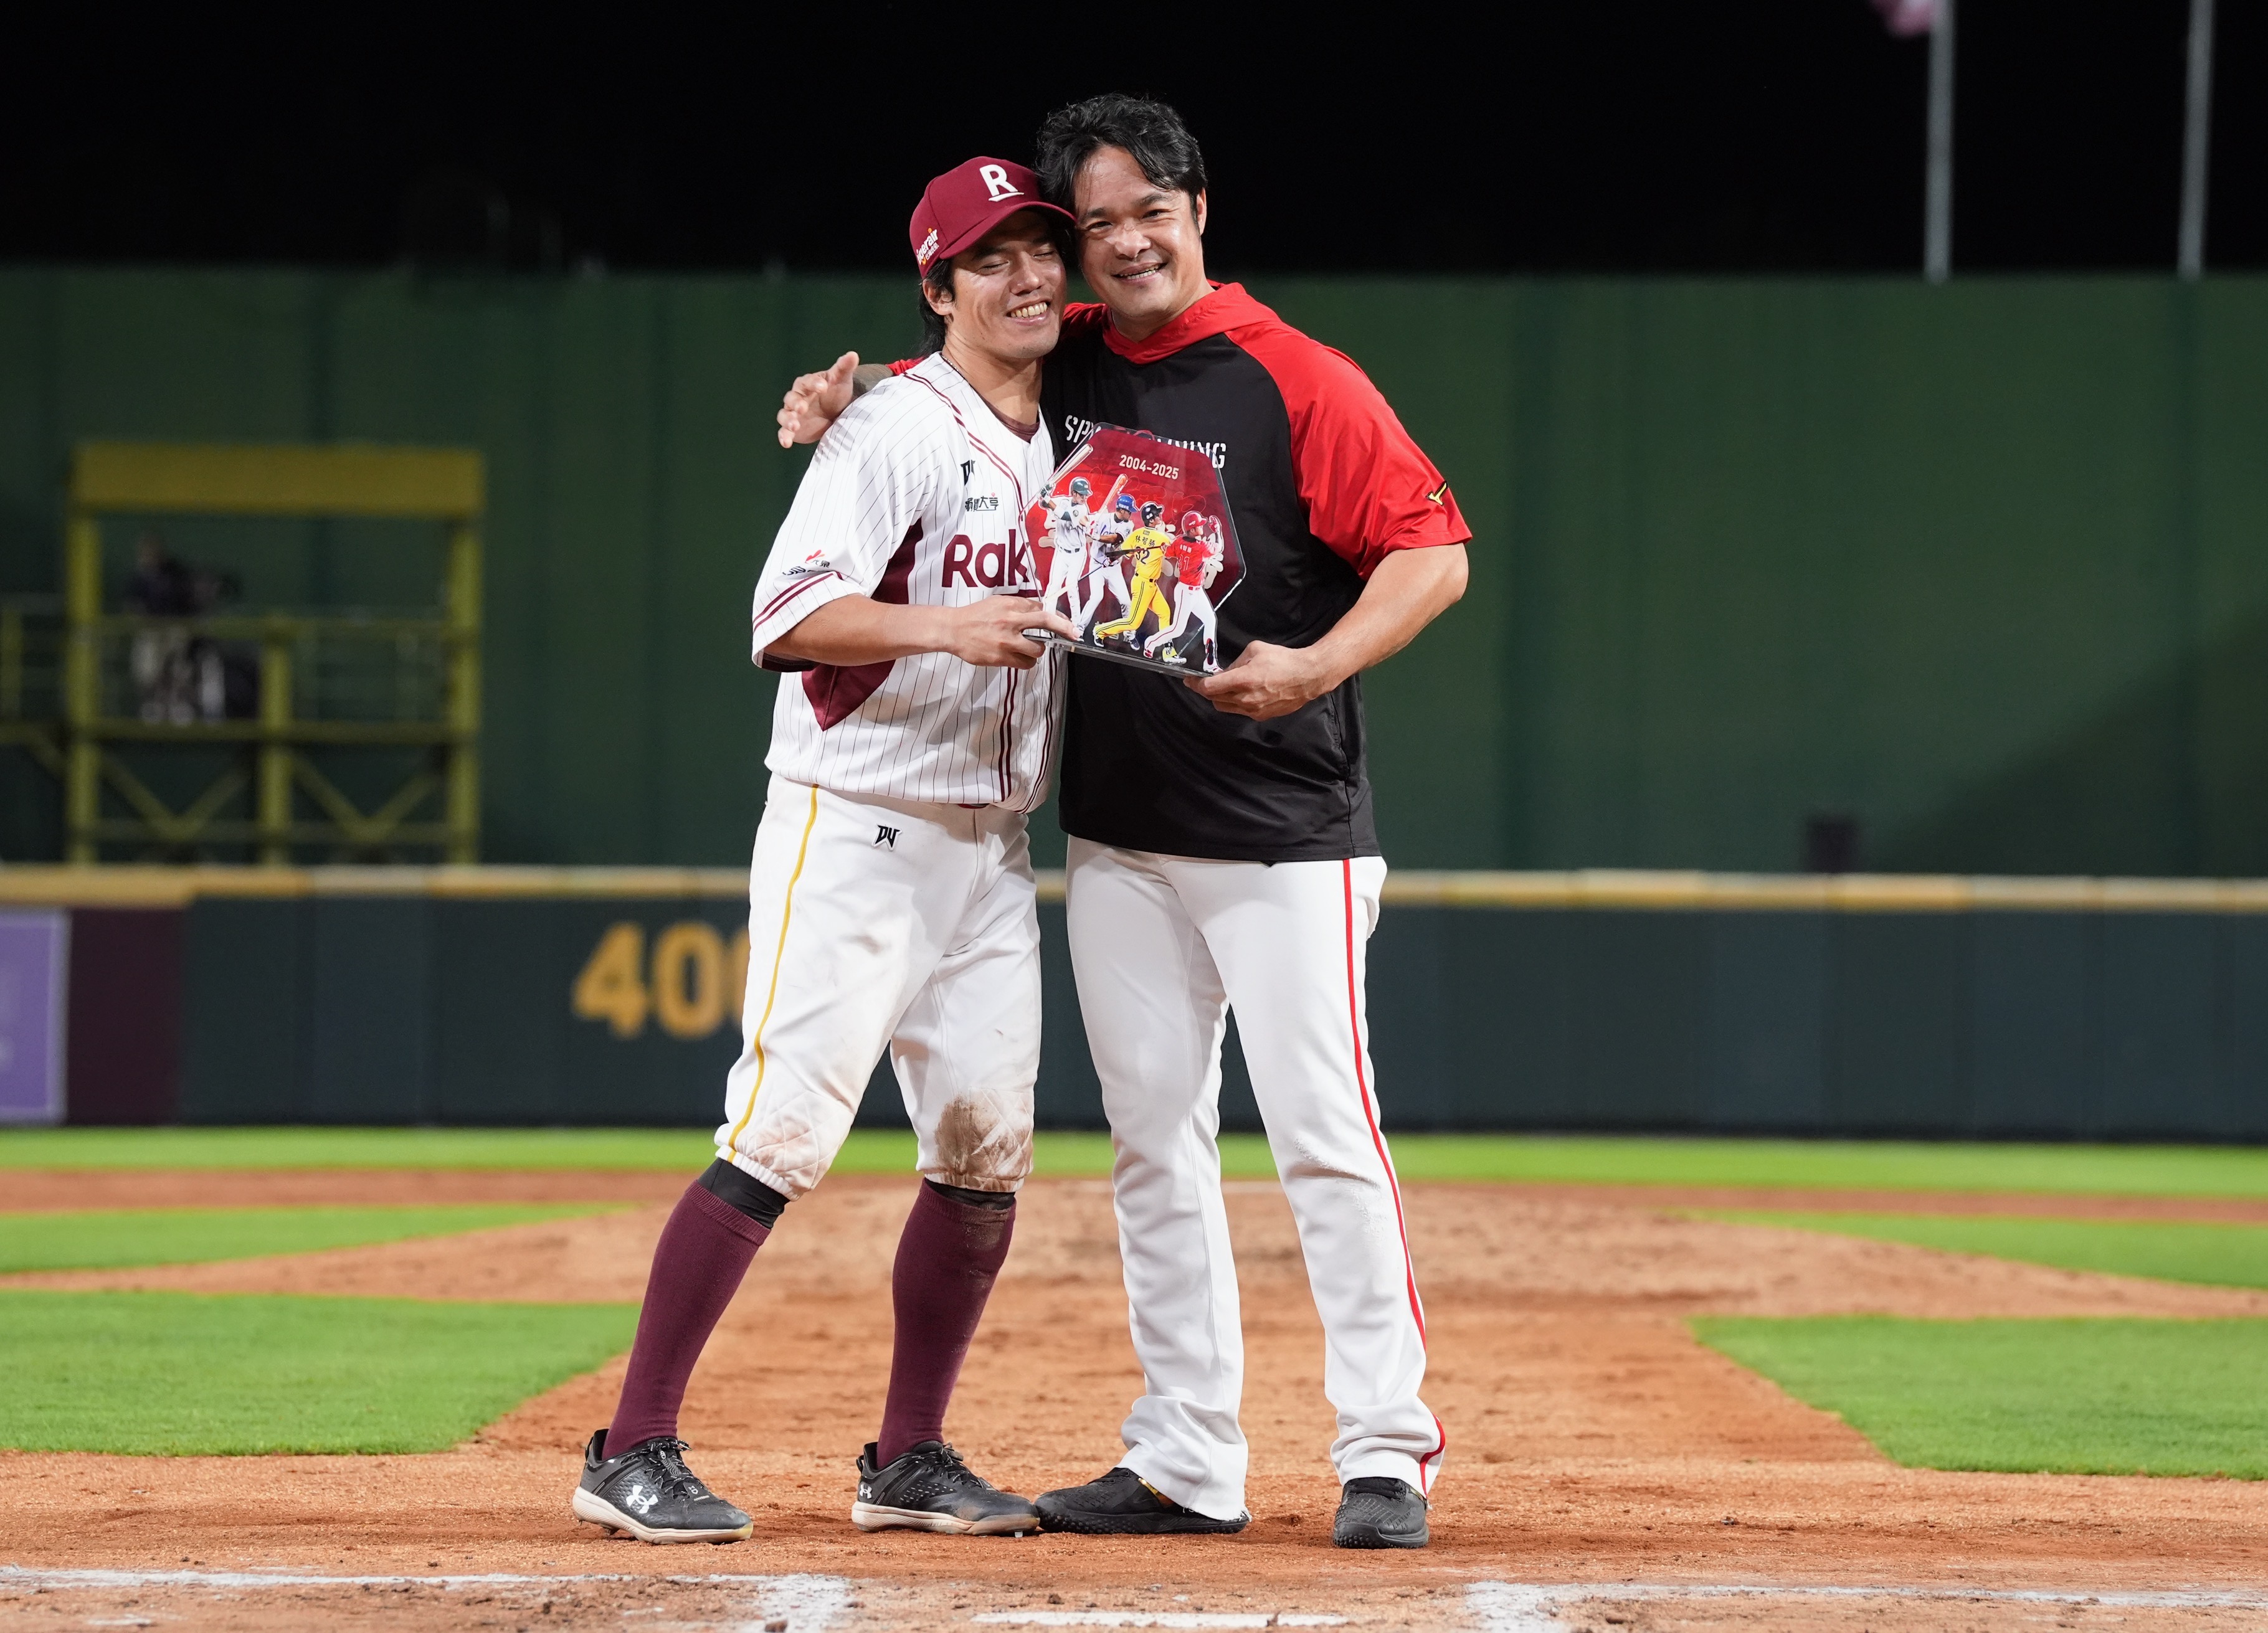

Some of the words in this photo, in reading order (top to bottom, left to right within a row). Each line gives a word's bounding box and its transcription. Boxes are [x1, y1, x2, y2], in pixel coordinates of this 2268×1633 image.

[979, 164, 1022, 199] R
[1119, 454, 1179, 480] 2004-2025
[571, 922, 751, 1039] 40
